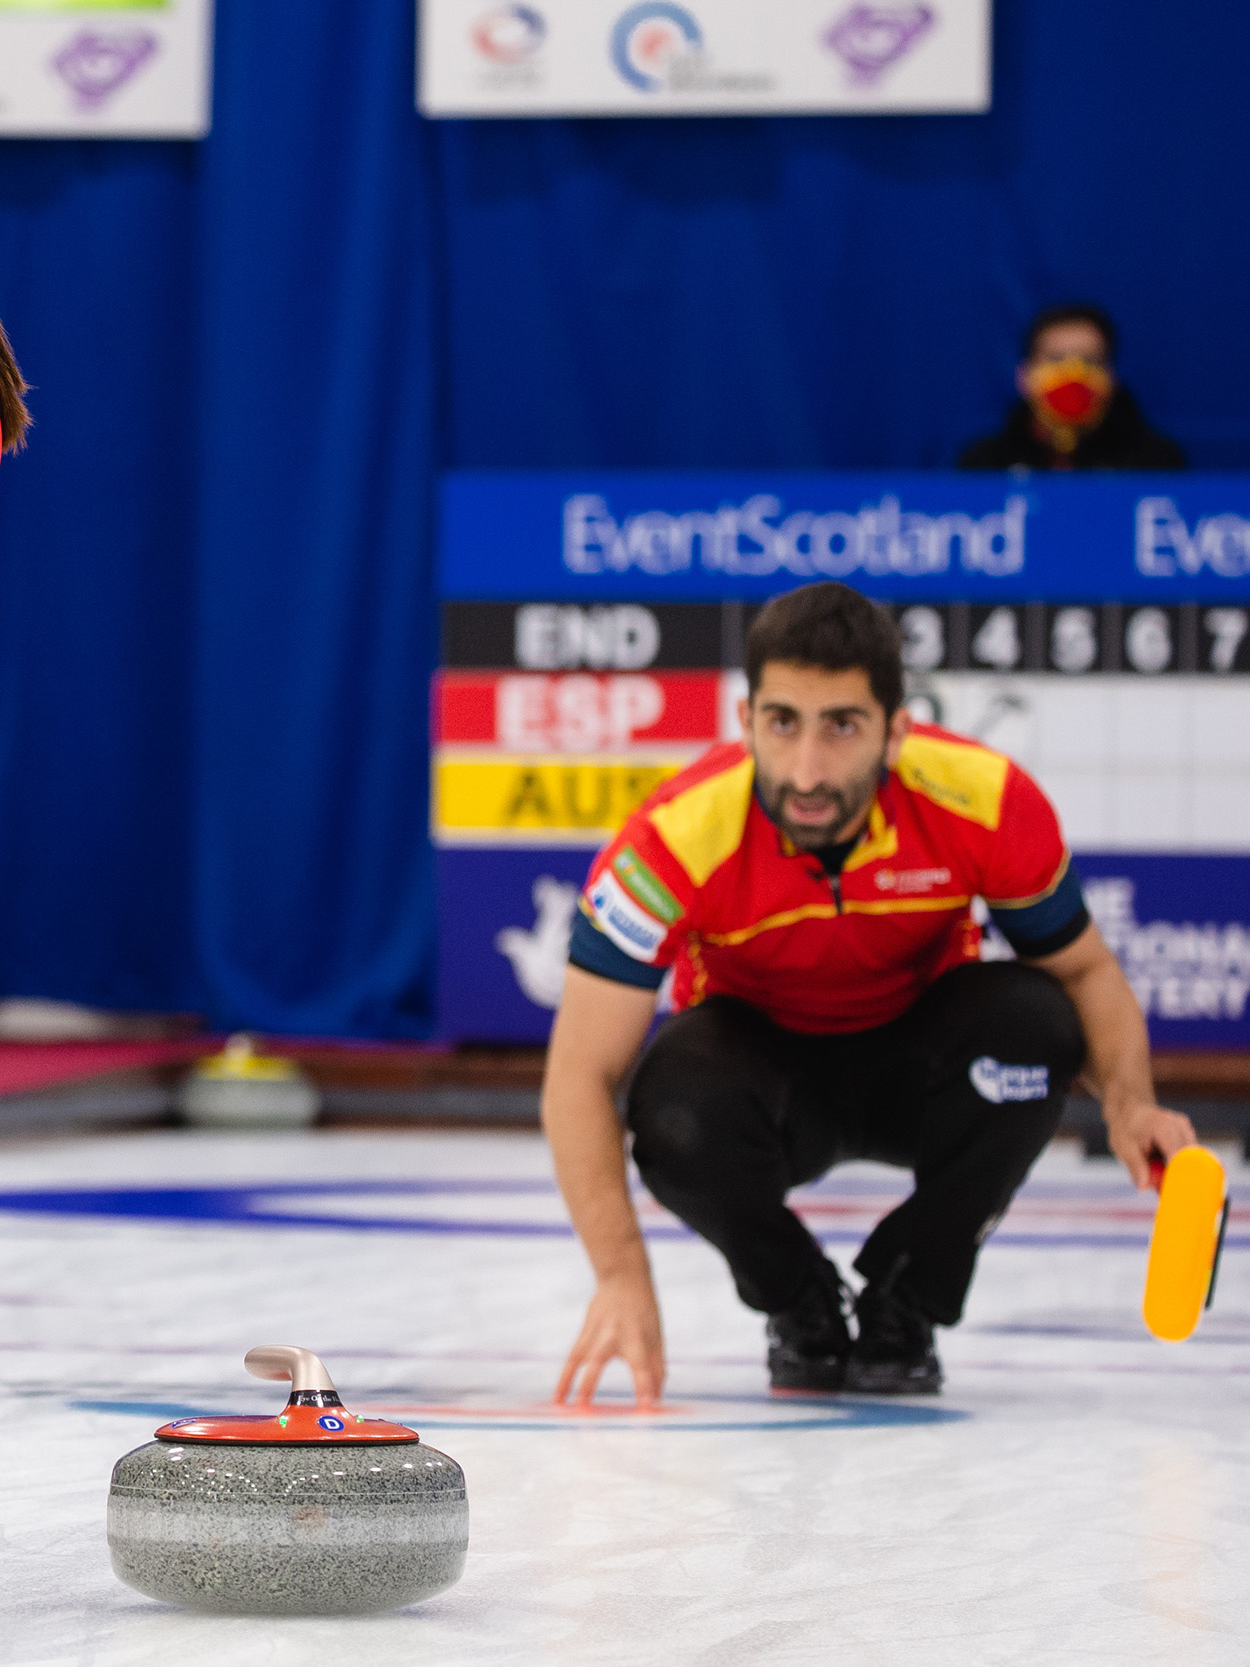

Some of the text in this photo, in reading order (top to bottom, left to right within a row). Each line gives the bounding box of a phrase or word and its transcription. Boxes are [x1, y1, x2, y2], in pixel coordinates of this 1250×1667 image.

[561, 494, 1026, 576] EventScotland
[515, 603, 1249, 674] END 3 4 5 6 7
[500, 671, 666, 752] ESP
[323, 1418, 340, 1430] D
